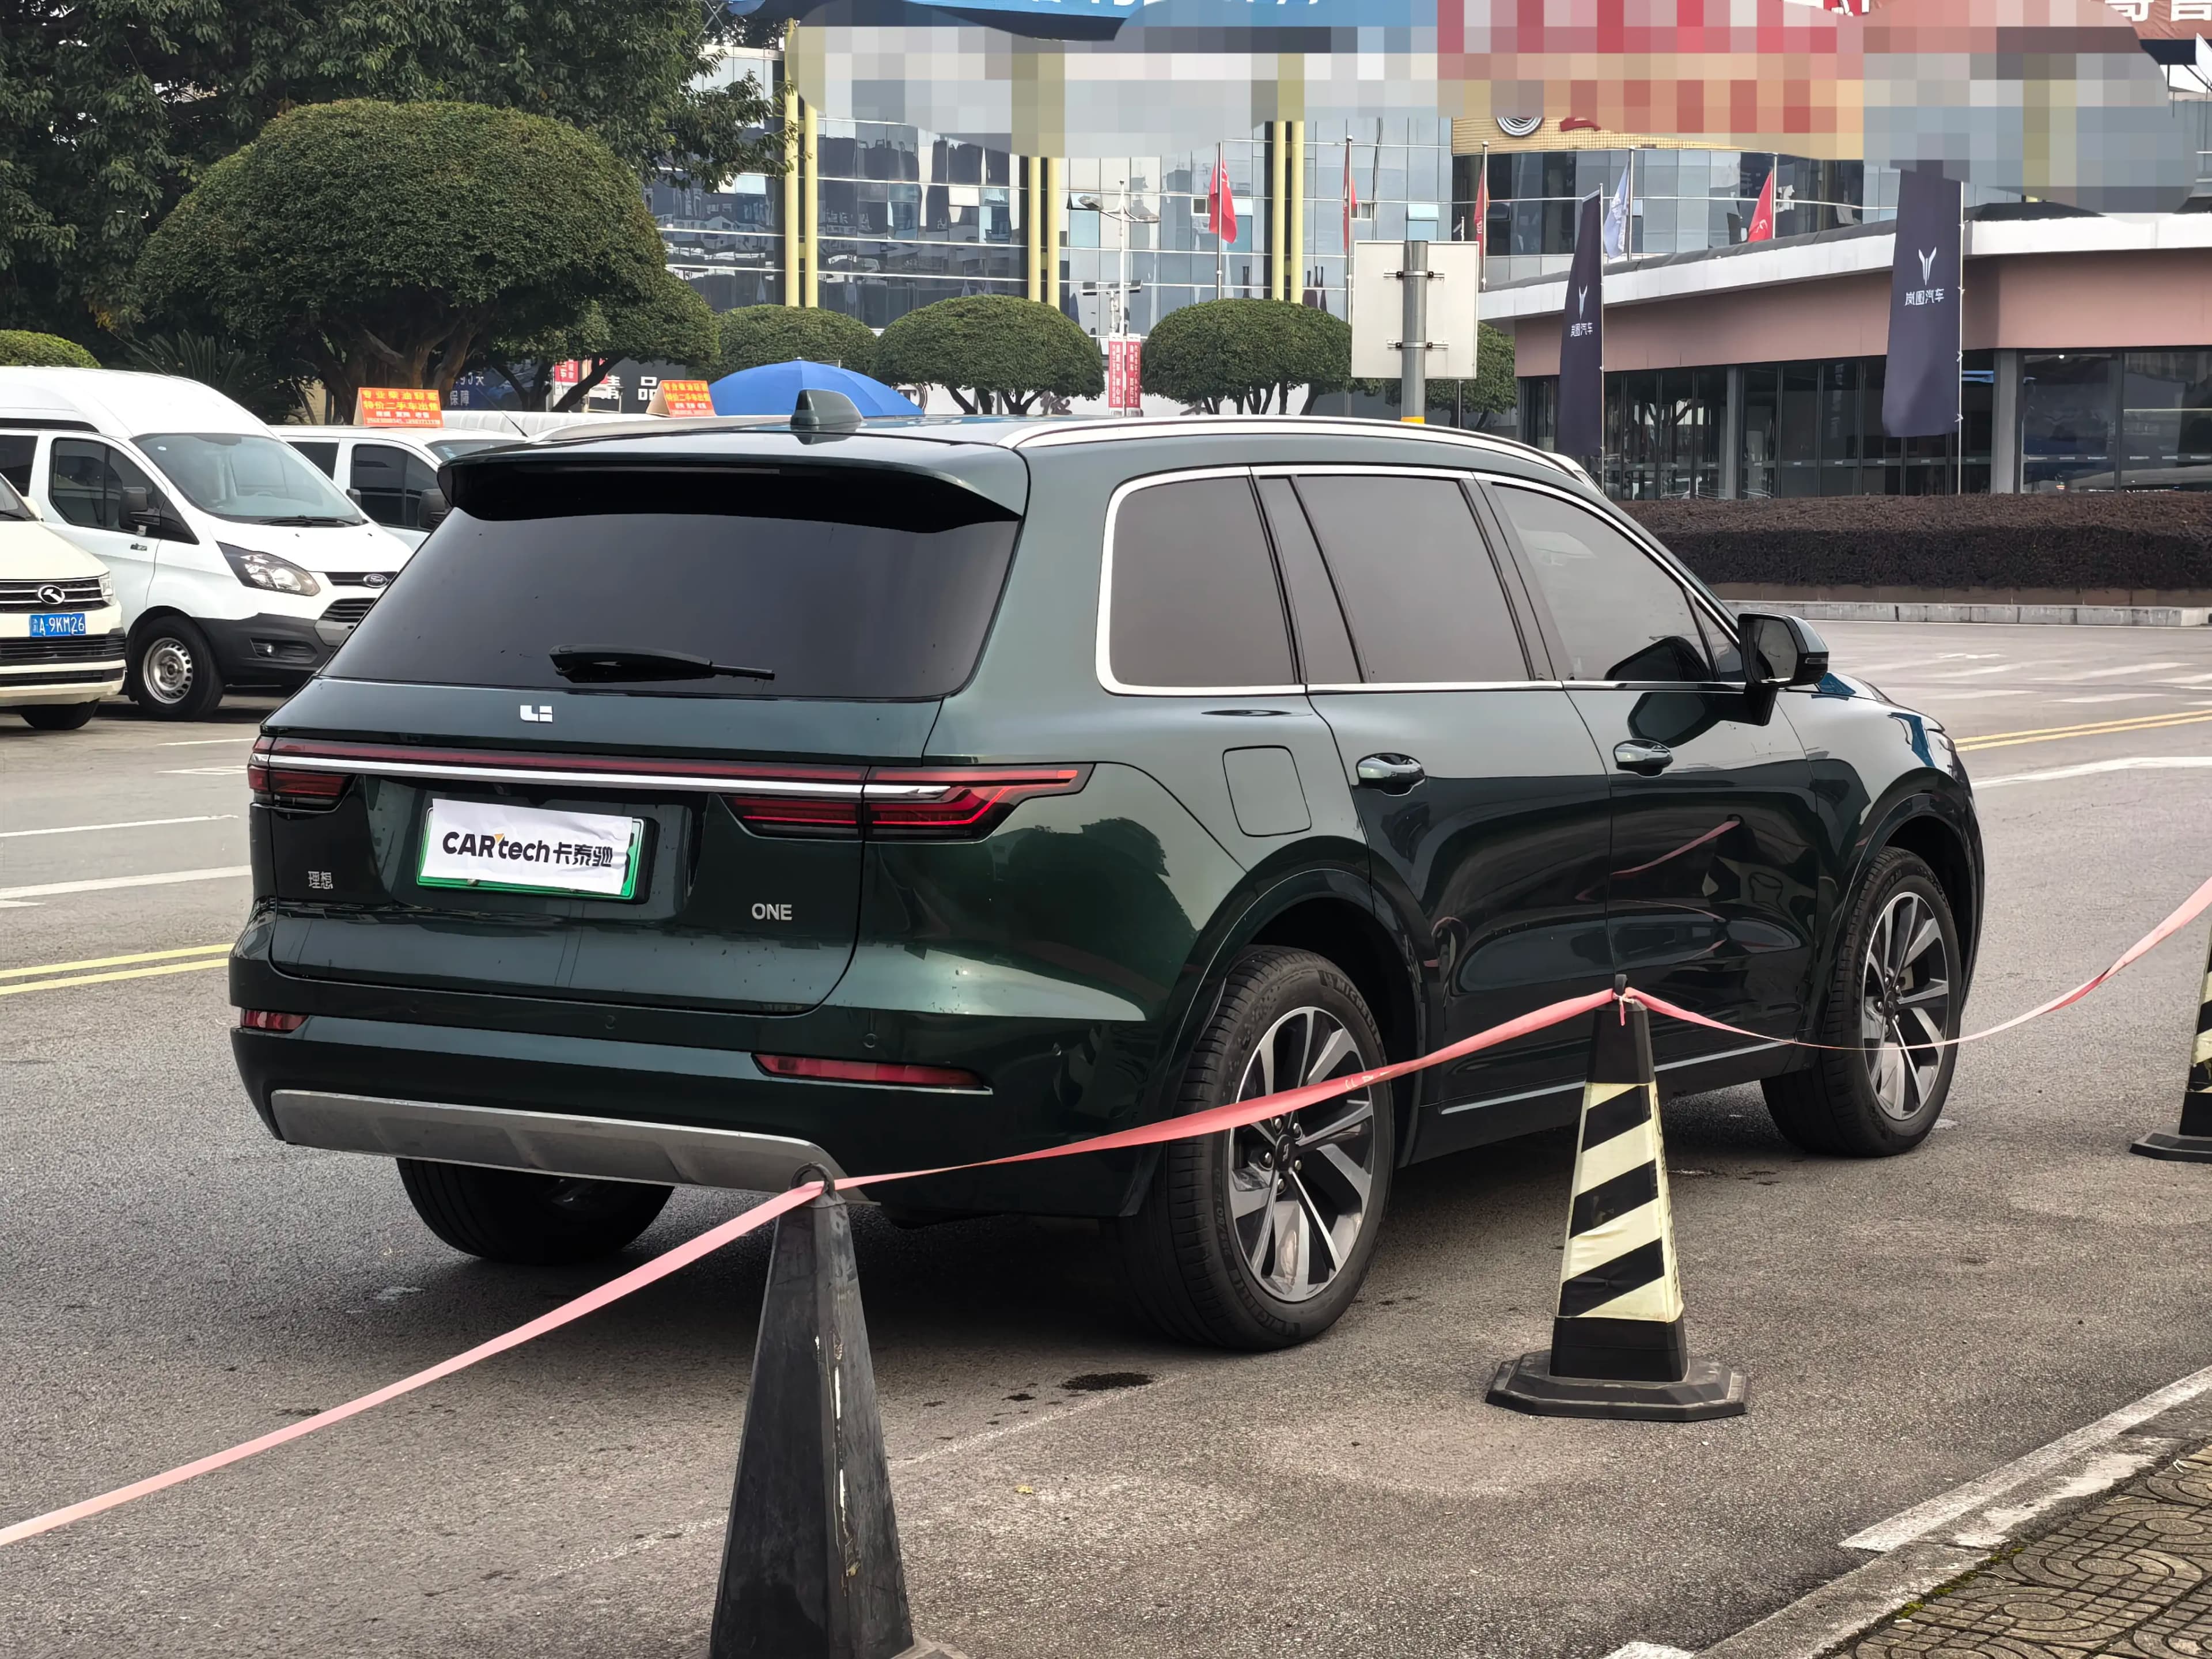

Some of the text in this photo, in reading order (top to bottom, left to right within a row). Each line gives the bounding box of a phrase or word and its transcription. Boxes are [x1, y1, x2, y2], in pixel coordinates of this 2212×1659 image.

[1904, 288, 1944, 306] 岚图汽车
[553, 842, 613, 868] 卡泰驰
[308, 870, 333, 889] 理想
[752, 903, 792, 920] ONE
